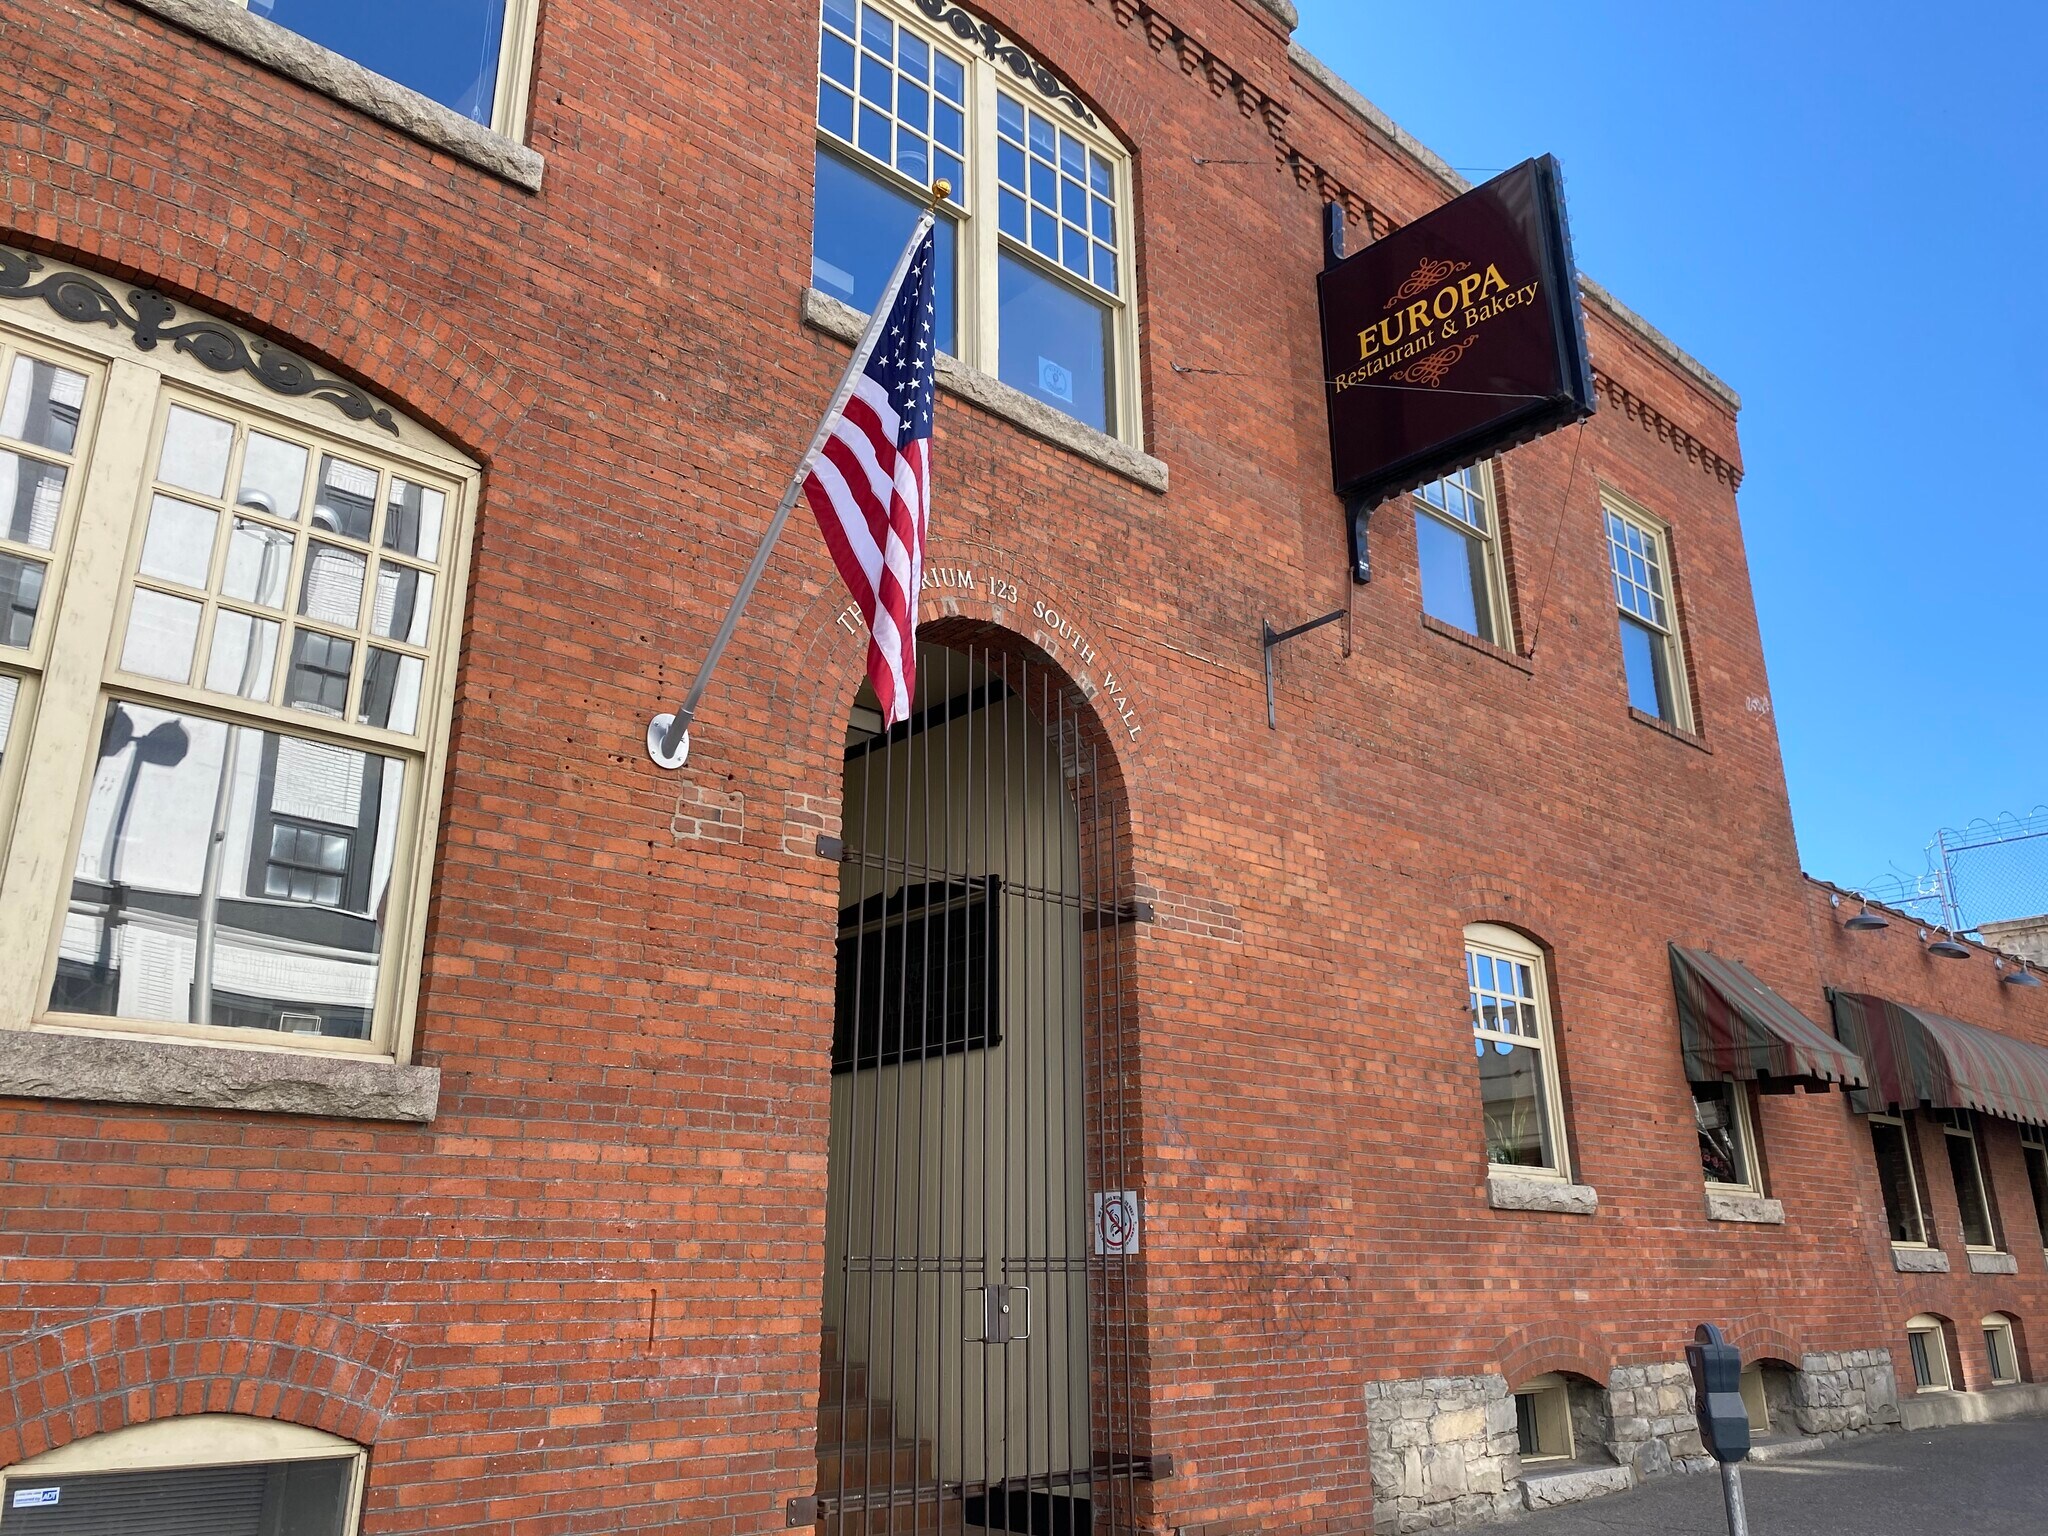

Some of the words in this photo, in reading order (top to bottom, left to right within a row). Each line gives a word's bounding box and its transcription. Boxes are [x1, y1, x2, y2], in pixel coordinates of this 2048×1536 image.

[1334, 330, 1436, 394] Restaurant
[1441, 318, 1459, 339] &
[1464, 280, 1539, 330] Bakery
[1357, 262, 1509, 361] EUROPA
[836, 600, 863, 635] TH
[921, 567, 975, 590] RIUM
[989, 576, 1018, 604] 123
[1033, 600, 1096, 666] SOUTH
[1103, 670, 1142, 742] WALL
[42, 1490, 57, 1501] ADT
